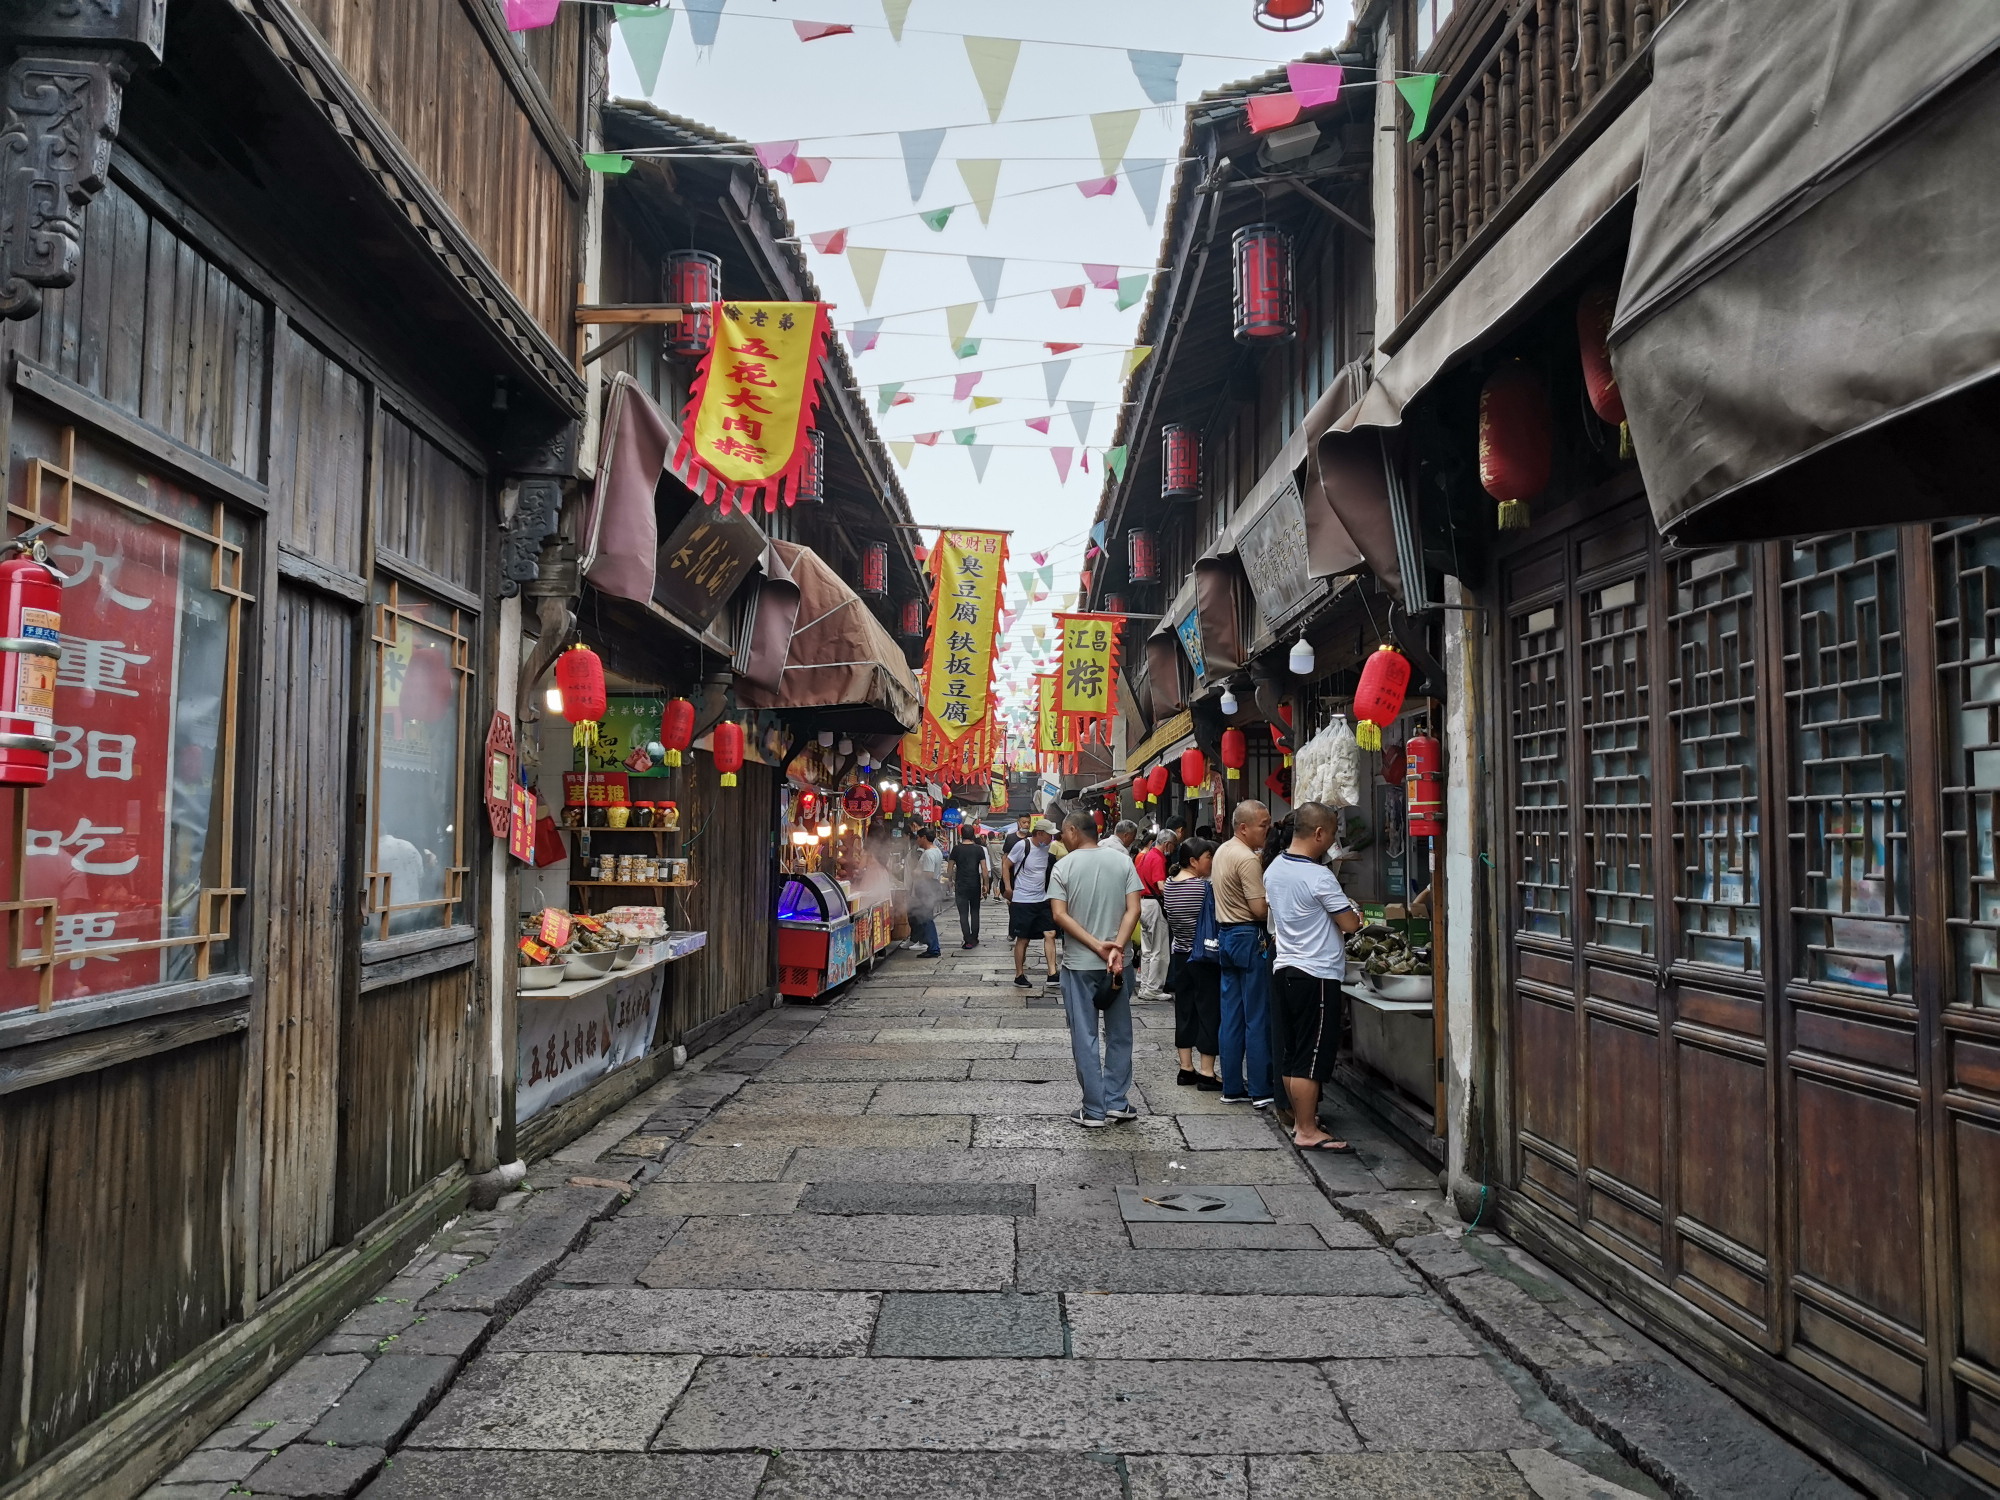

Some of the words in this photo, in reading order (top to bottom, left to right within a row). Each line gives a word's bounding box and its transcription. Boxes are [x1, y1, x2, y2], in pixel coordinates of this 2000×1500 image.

[711, 337, 779, 465] 五花大肉粽
[948, 533, 998, 555] 聚财昌
[1067, 629, 1107, 652] 汇昌
[1066, 658, 1105, 699] 粽
[528, 1020, 598, 1088] 五花大肉粽
